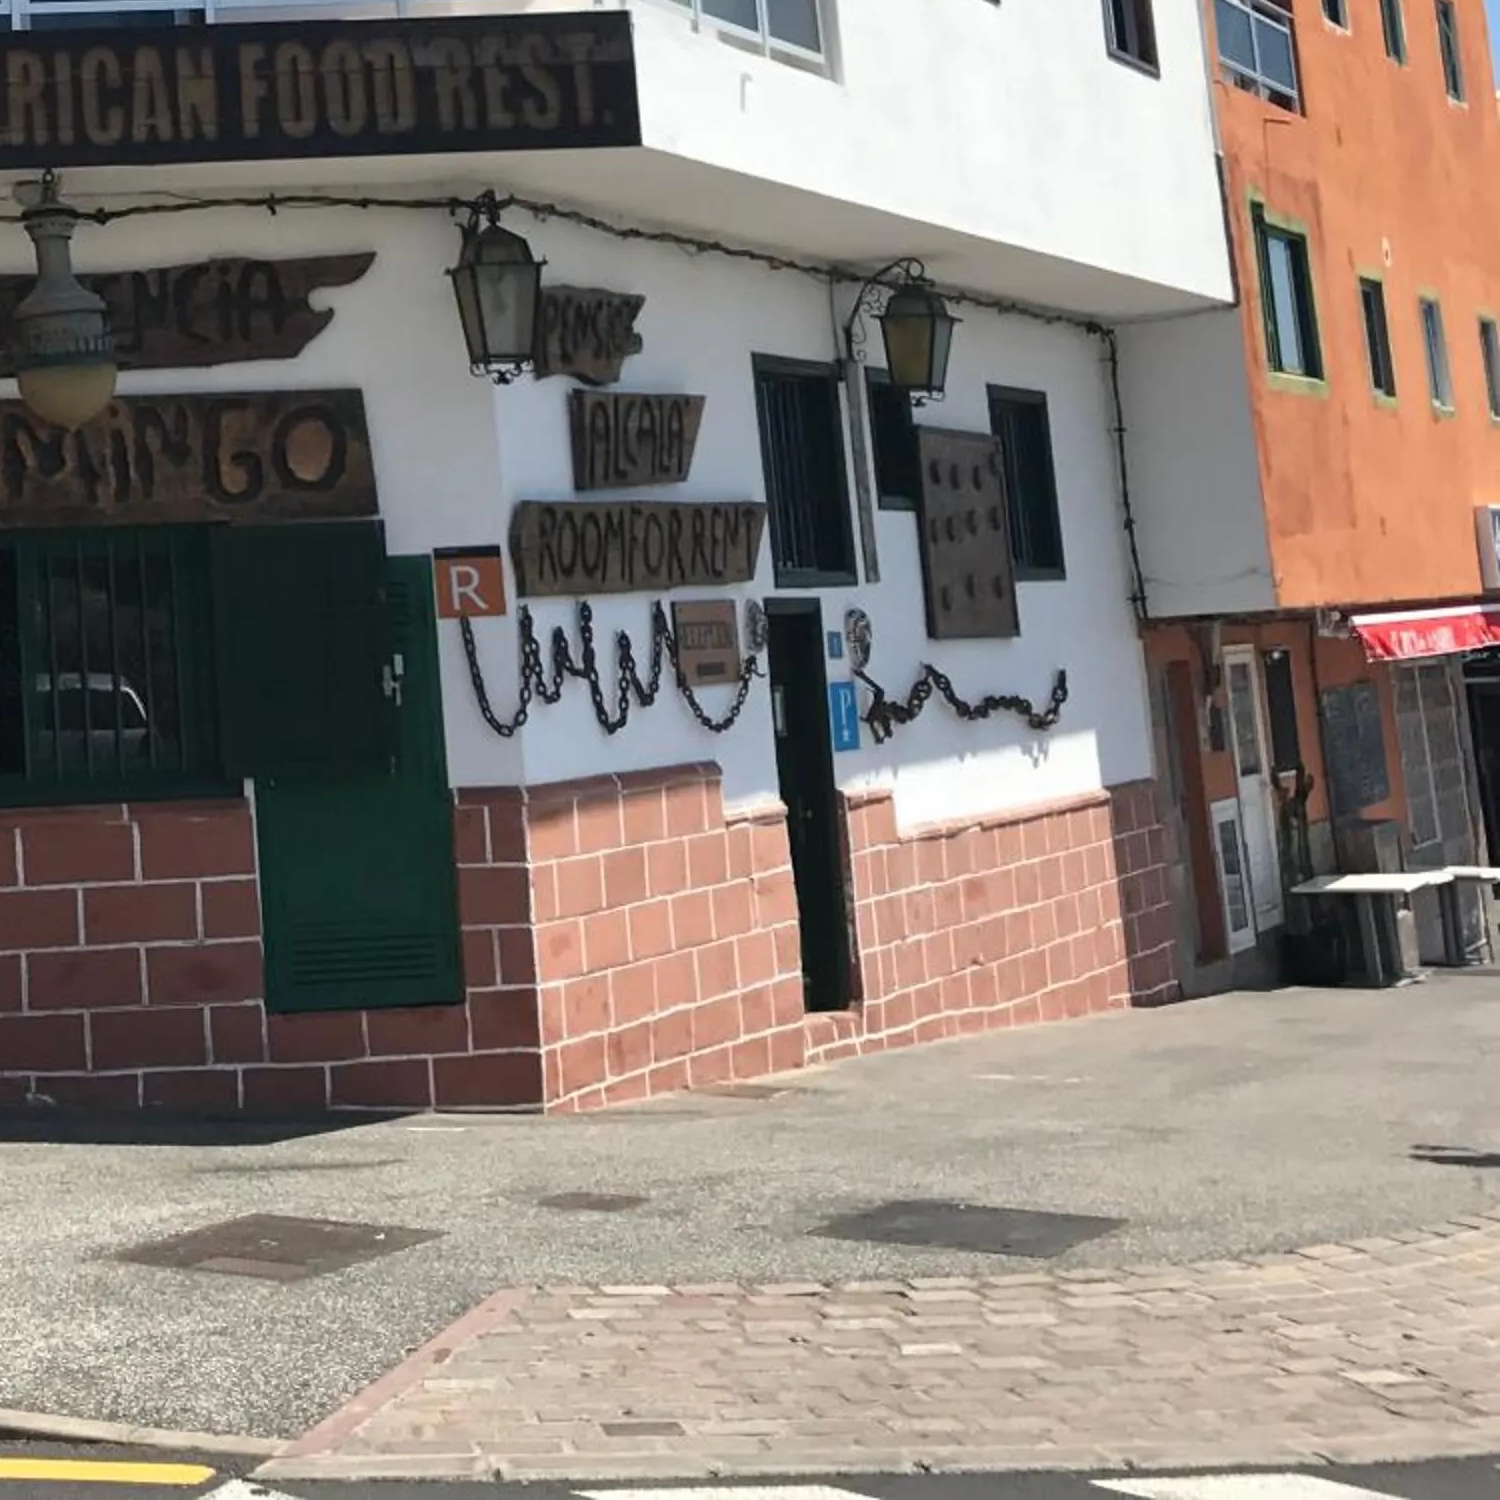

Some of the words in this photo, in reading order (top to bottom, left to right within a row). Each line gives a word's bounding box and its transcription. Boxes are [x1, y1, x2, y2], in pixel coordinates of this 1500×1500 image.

[239, 36, 417, 139] FOOD
[538, 507, 627, 584] ROOM
[629, 506, 686, 586] FOR
[691, 509, 757, 579] RENT
[450, 566, 489, 610] R
